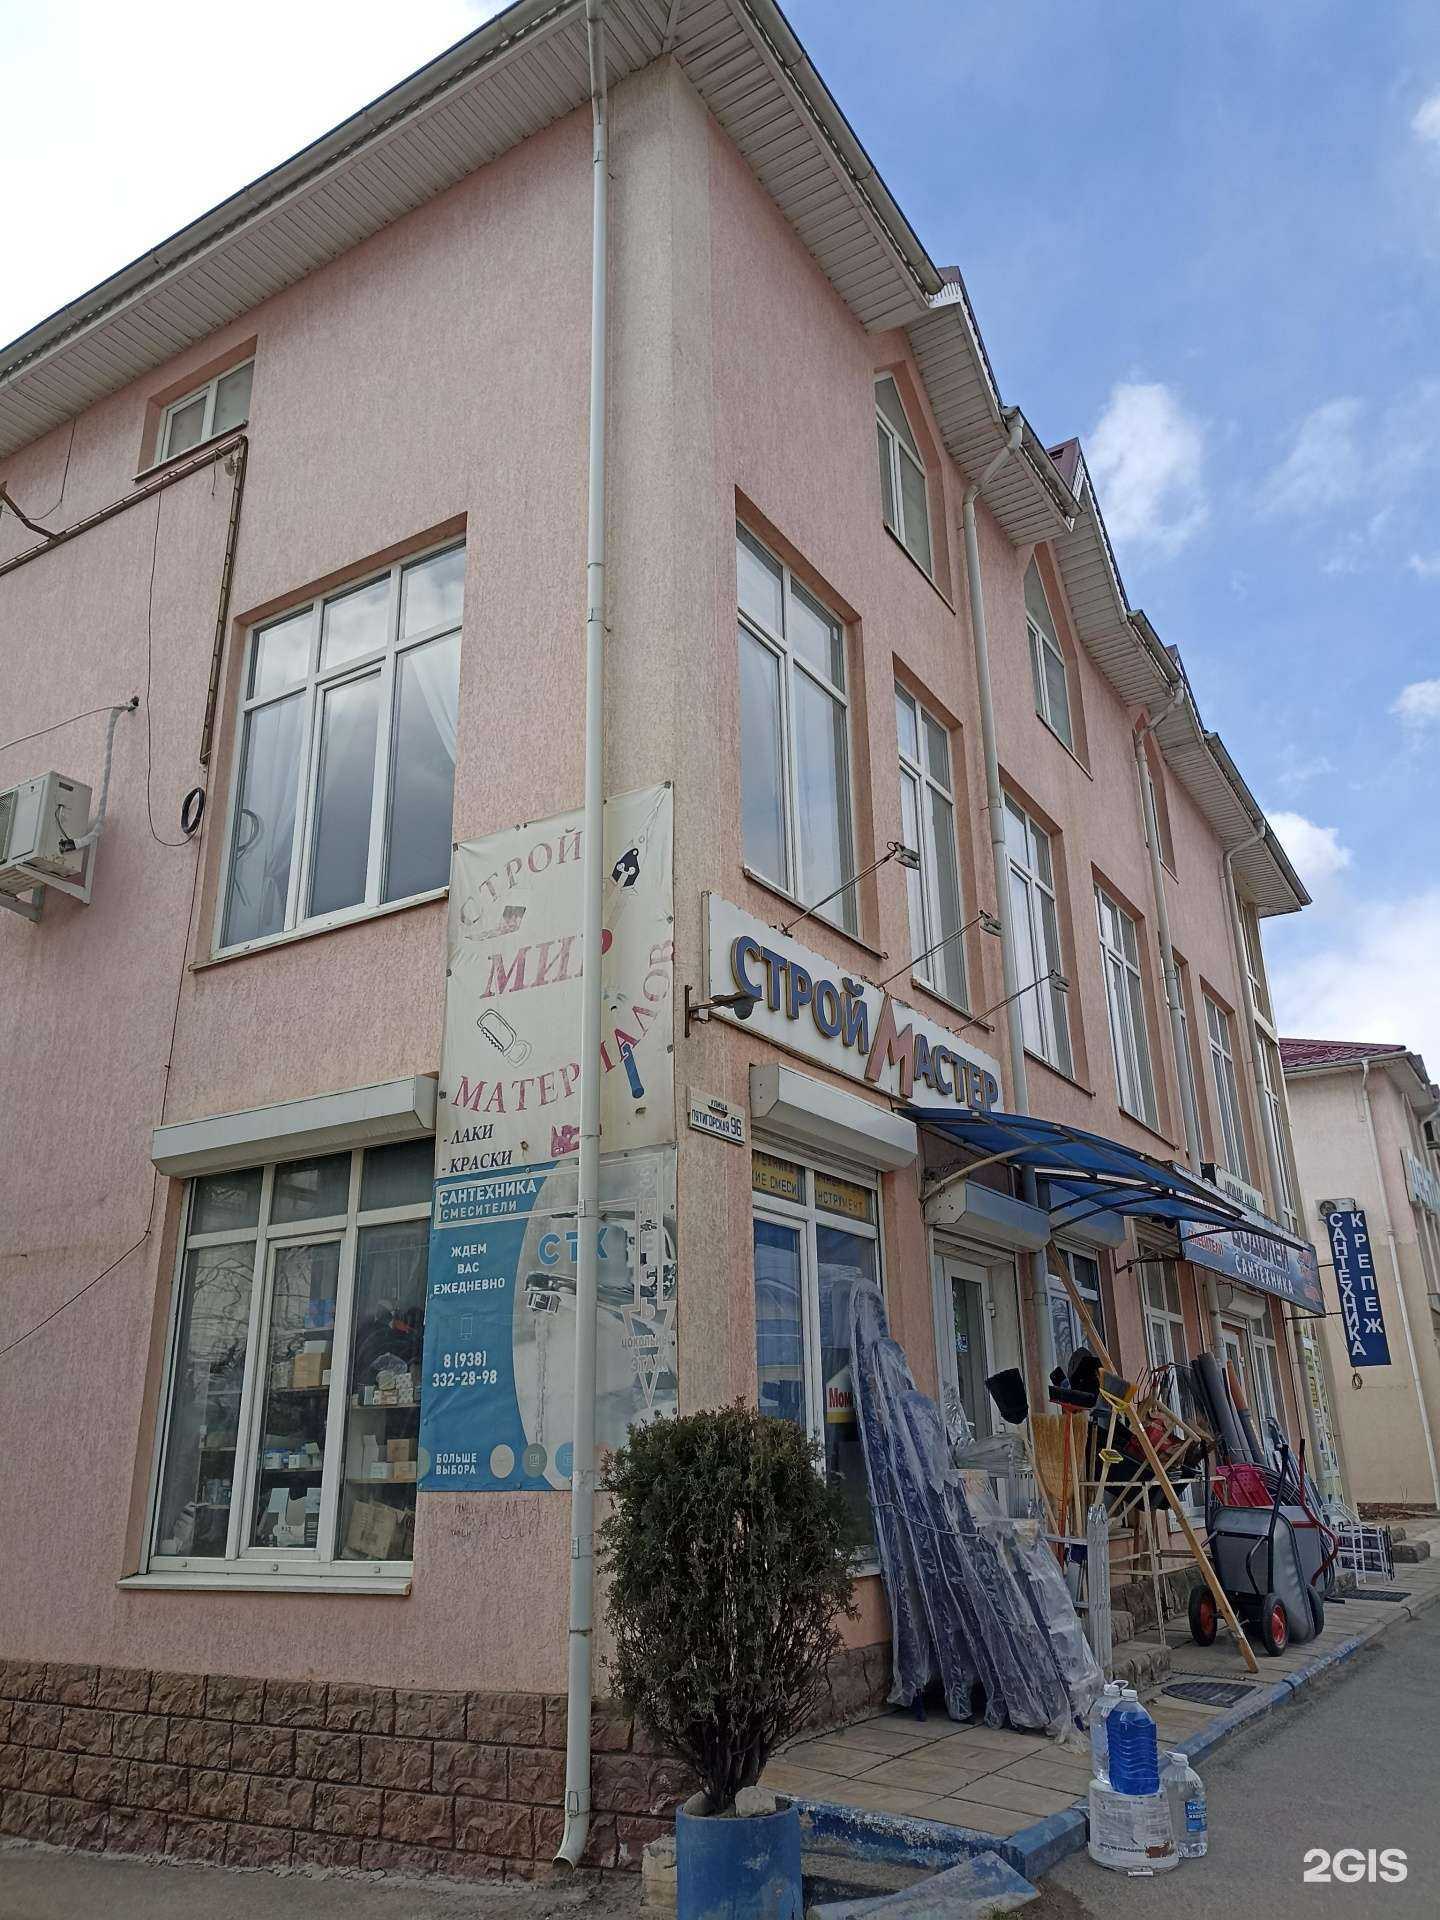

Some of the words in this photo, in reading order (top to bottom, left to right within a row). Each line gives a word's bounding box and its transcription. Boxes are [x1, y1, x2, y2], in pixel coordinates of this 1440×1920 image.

[460, 827, 583, 925] СТРОЙ
[451, 1124, 494, 1144] ЛАКИ
[730, 1116, 742, 1136] 96
[449, 1150, 513, 1173] КРАСКИ
[440, 1179, 537, 1206] САНТЕХНИКА
[442, 1200, 517, 1219] СМЕСИТЕЛИ
[451, 1243, 487, 1257] ЖДЕМ
[457, 1262, 479, 1273] ВАС
[1350, 1213, 1384, 1333] КРЕПЕЖ
[434, 1277, 505, 1295] ЕЖЕДНЕВНО
[1329, 1212, 1367, 1356] САНТЕХНИКА
[444, 1354, 451, 1367] 8
[454, 1350, 486, 1368] (938)
[432, 1370, 498, 1387] 332-28-98
[436, 1453, 477, 1464] БОЛЬШЕ
[436, 1465, 476, 1475] ВЫБОРА
